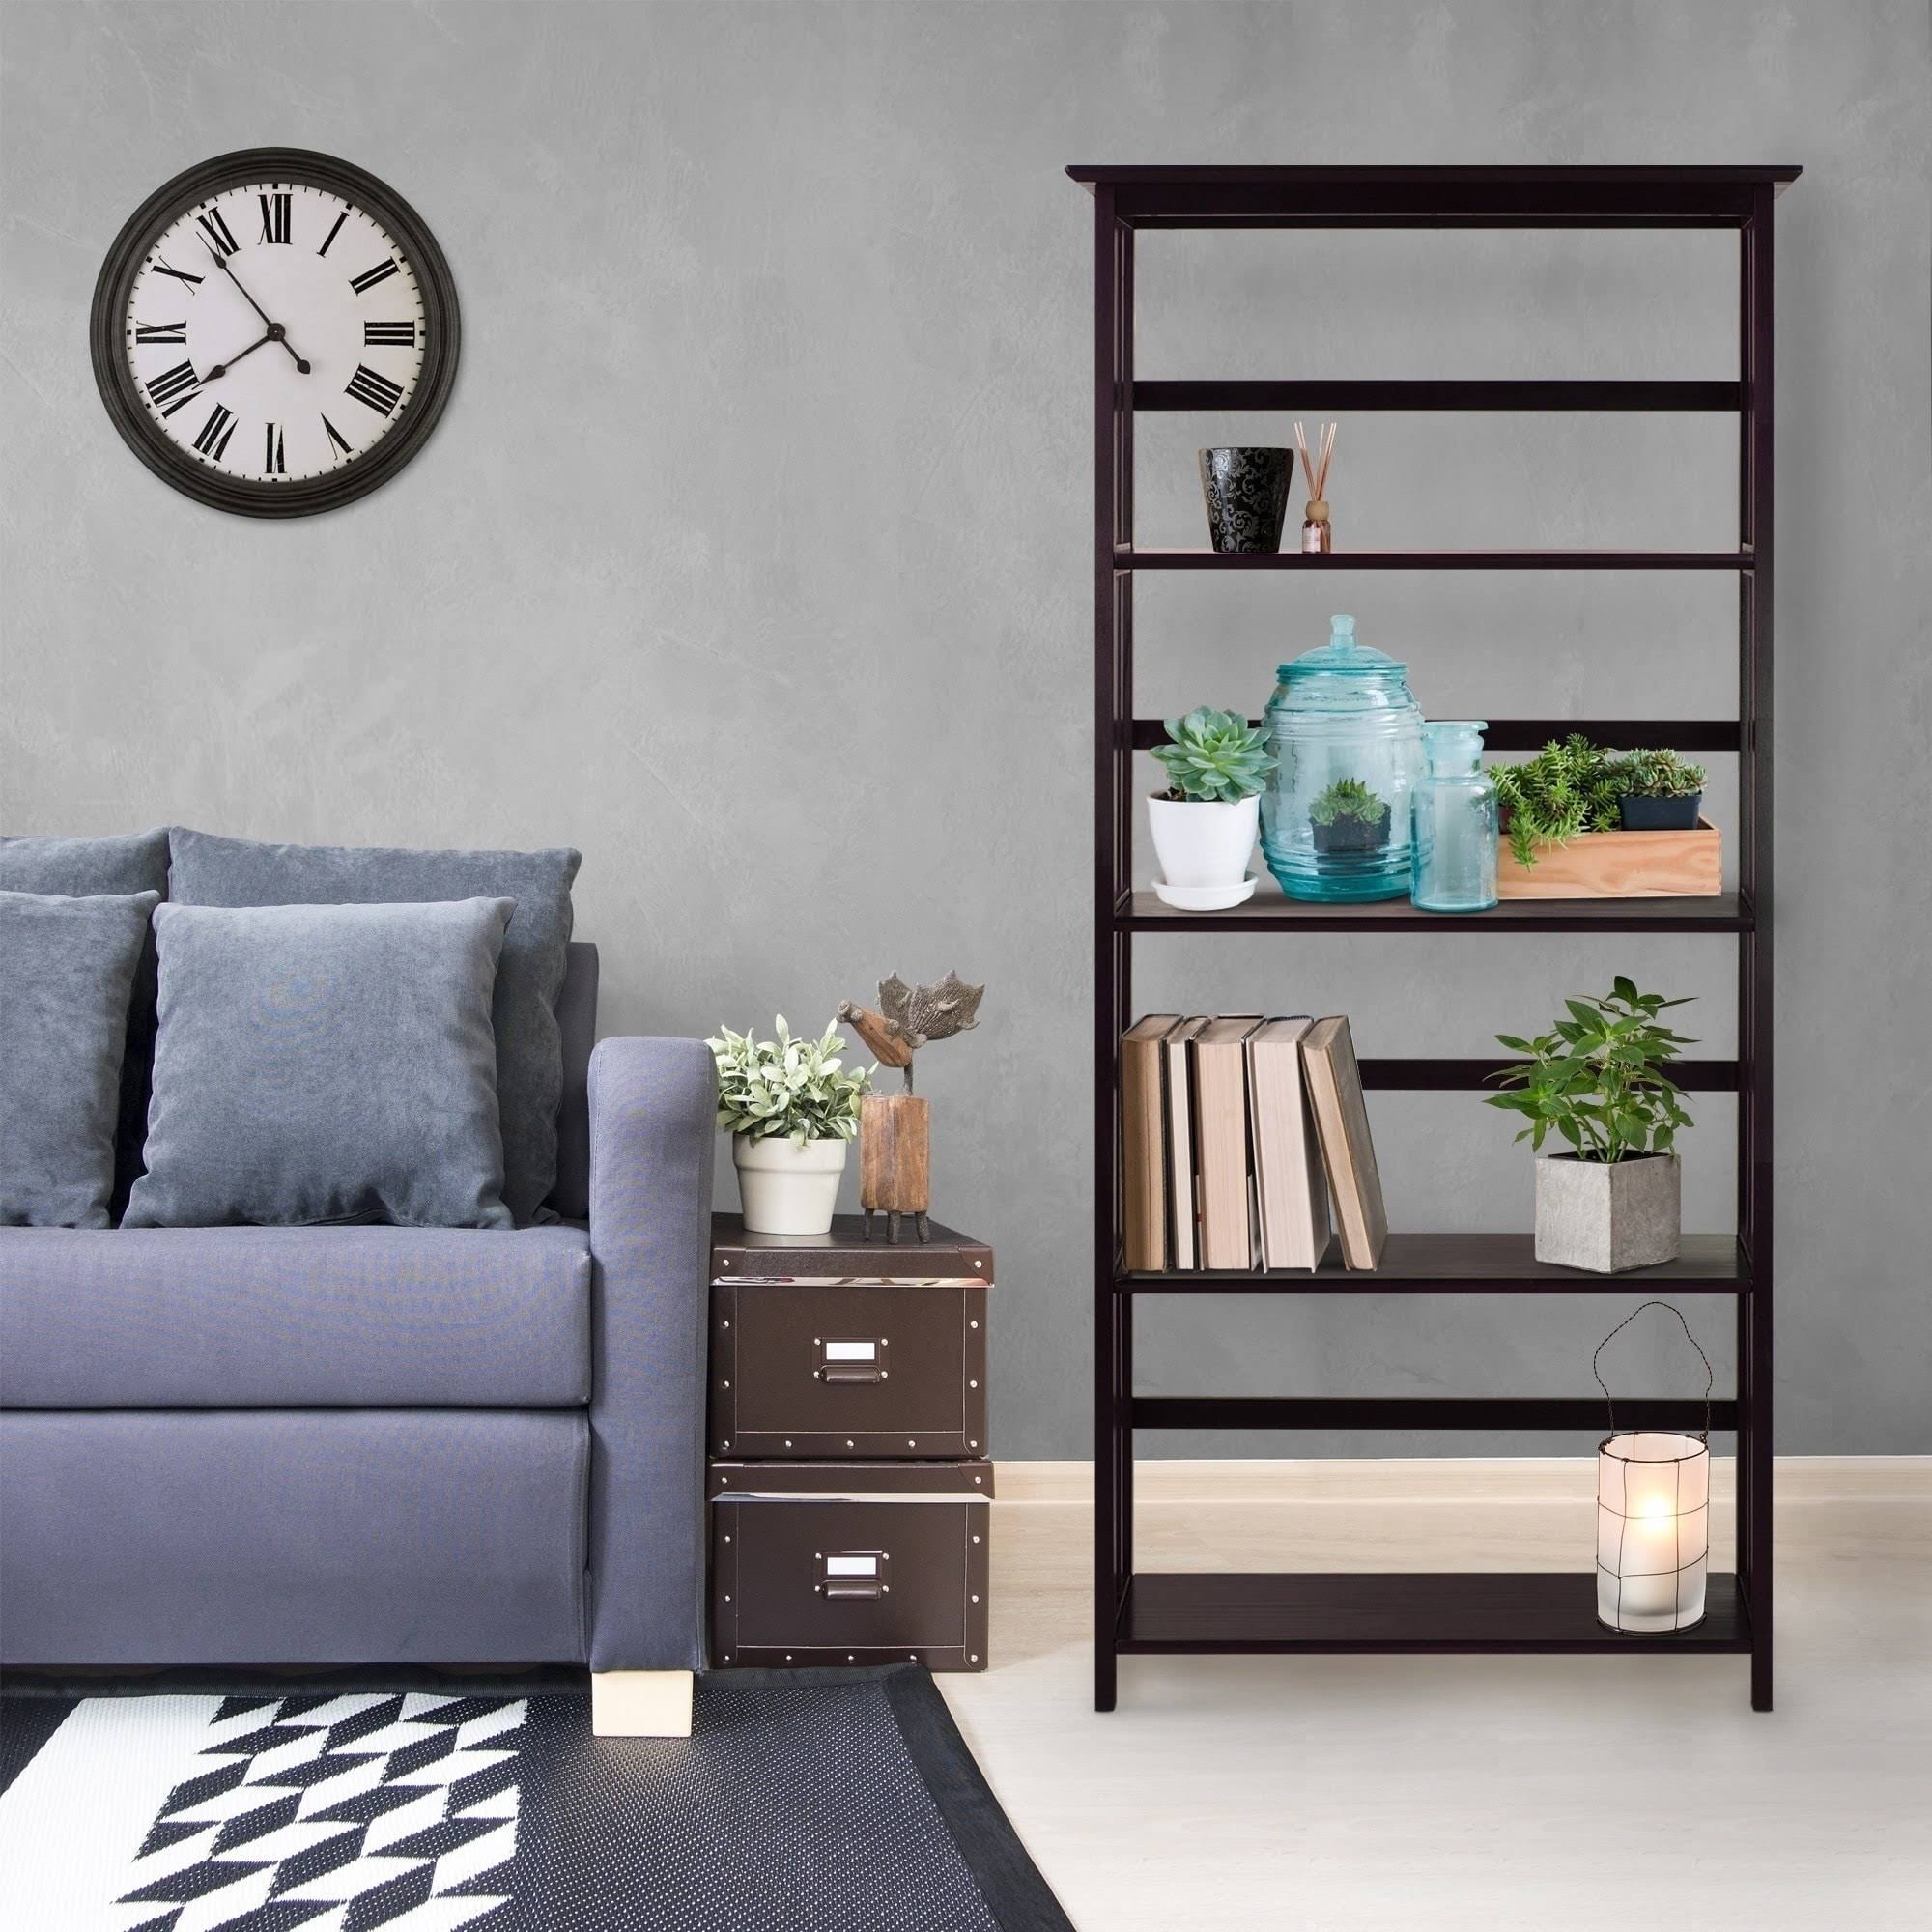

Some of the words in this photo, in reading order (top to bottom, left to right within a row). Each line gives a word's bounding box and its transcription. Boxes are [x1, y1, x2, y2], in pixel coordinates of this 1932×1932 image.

[257, 194, 293, 245] XII
[317, 211, 350, 258] I
[151, 256, 206, 296] X
[348, 255, 401, 297] II
[136, 320, 186, 345] IX
[364, 320, 415, 348] III
[191, 402, 240, 463] VII
[264, 422, 288, 473] VI
[321, 412, 355, 461] V
